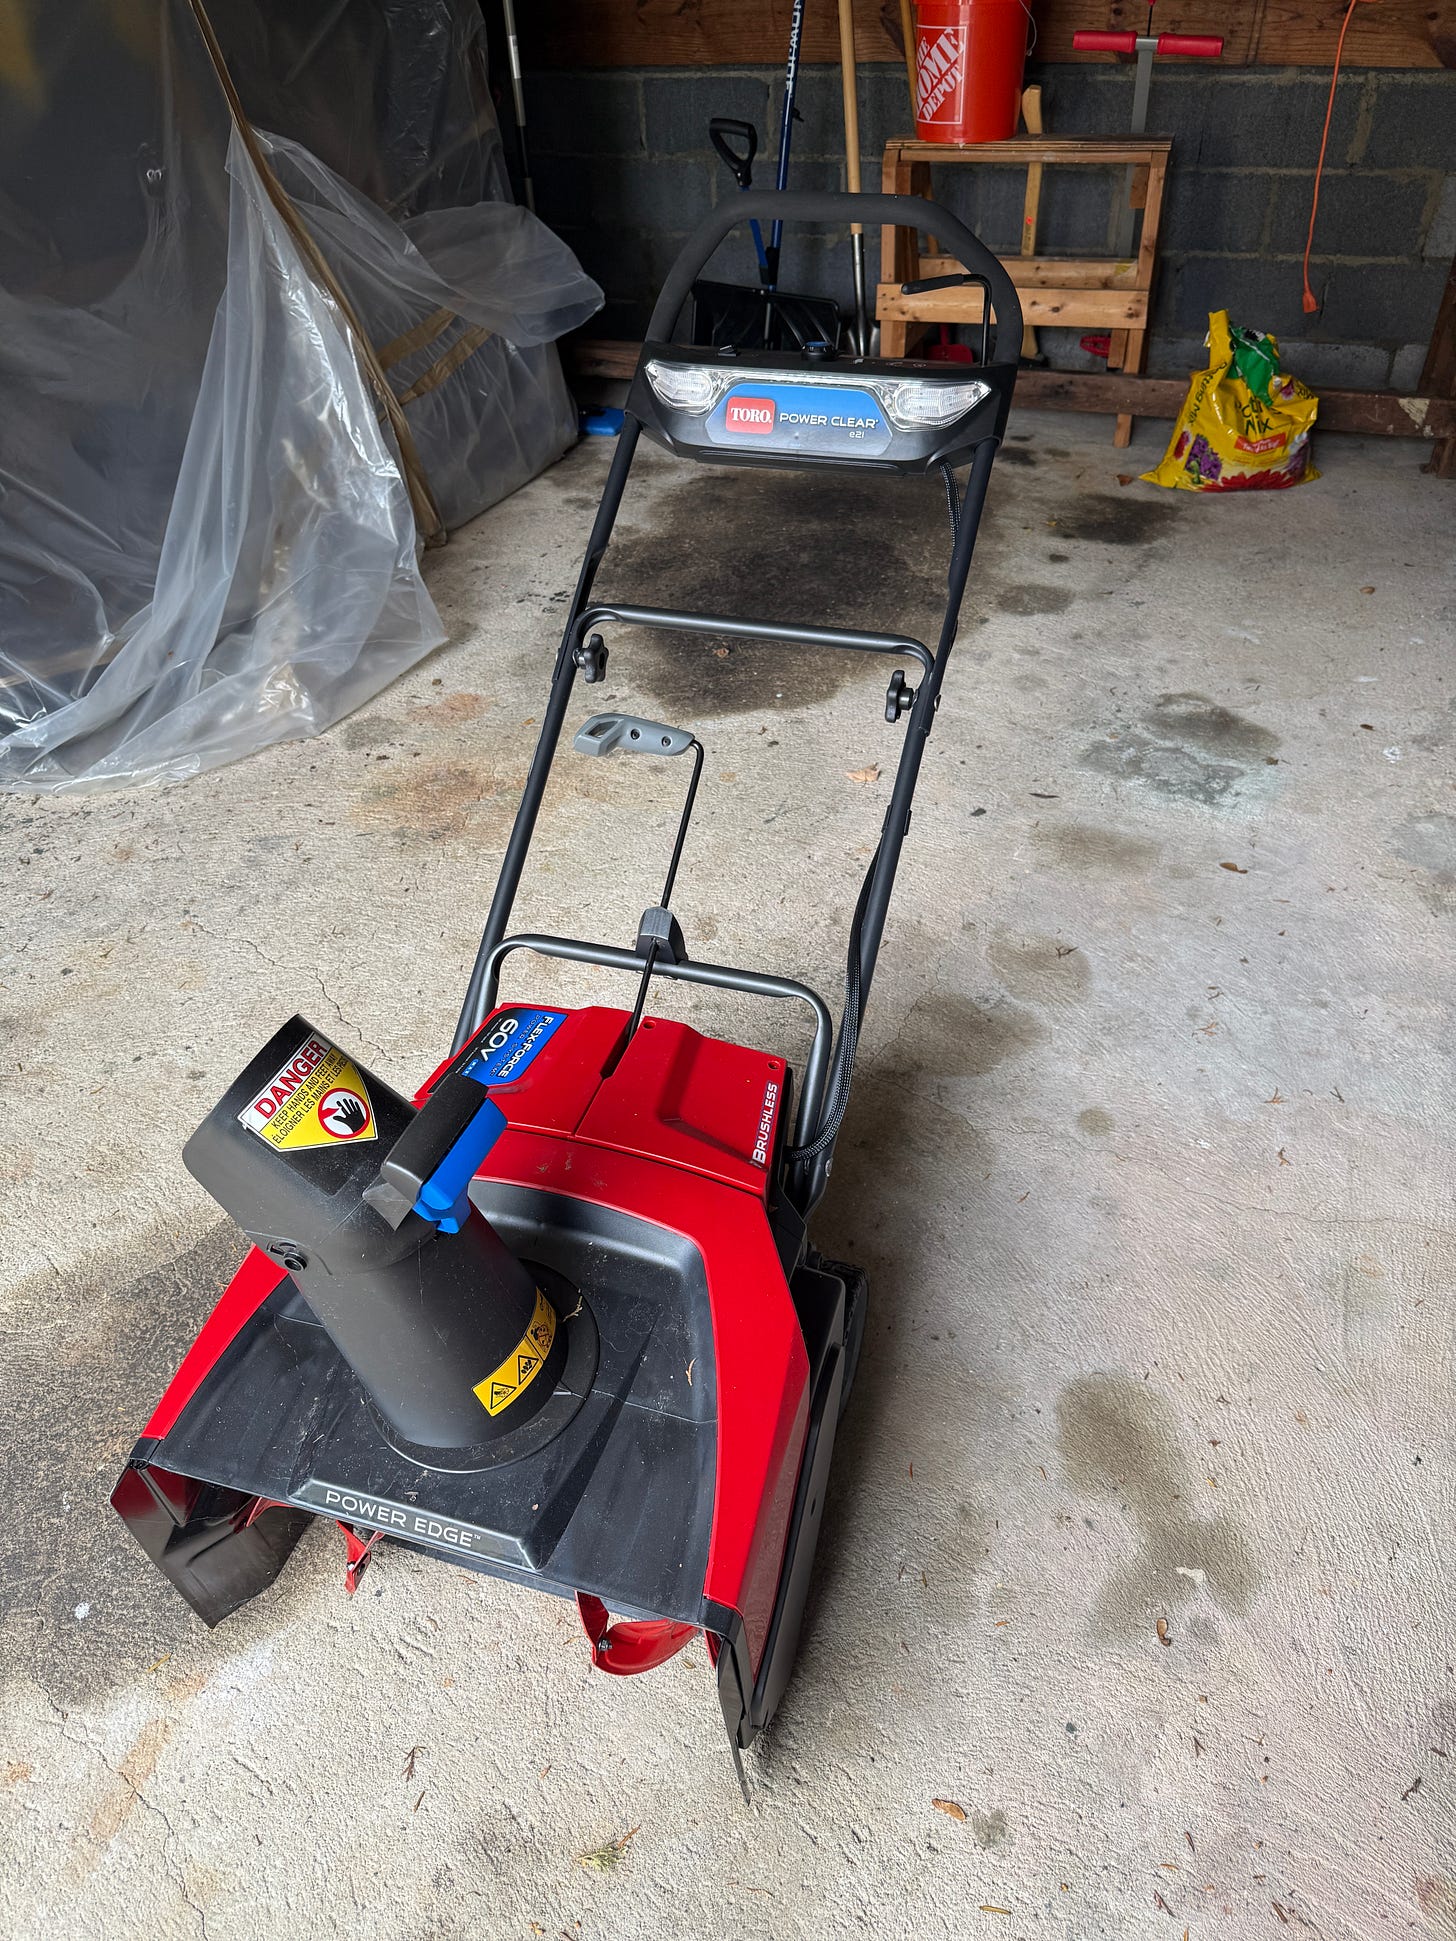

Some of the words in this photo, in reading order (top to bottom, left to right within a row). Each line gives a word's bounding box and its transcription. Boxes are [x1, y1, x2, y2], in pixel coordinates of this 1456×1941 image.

[922, 64, 964, 121] DEPOT
[731, 407, 772, 424] TORO
[779, 413, 828, 426] POWER
[481, 1018, 519, 1062] 60V
[254, 1040, 328, 1120] DANGER
[271, 1109, 289, 1130] KEEP
[288, 1088, 310, 1113] HANDS
[305, 1077, 320, 1093] AND
[314, 1063, 331, 1080] FEET
[271, 1110, 305, 1144] ÉLOIGNER
[300, 1098, 316, 1114] LES
[311, 1080, 331, 1102] MAINS
[325, 1072, 337, 1085] ET
[332, 1064, 343, 1079] LES
[752, 1082, 778, 1164] BRUSHLESS
[325, 1489, 407, 1528] POWER
